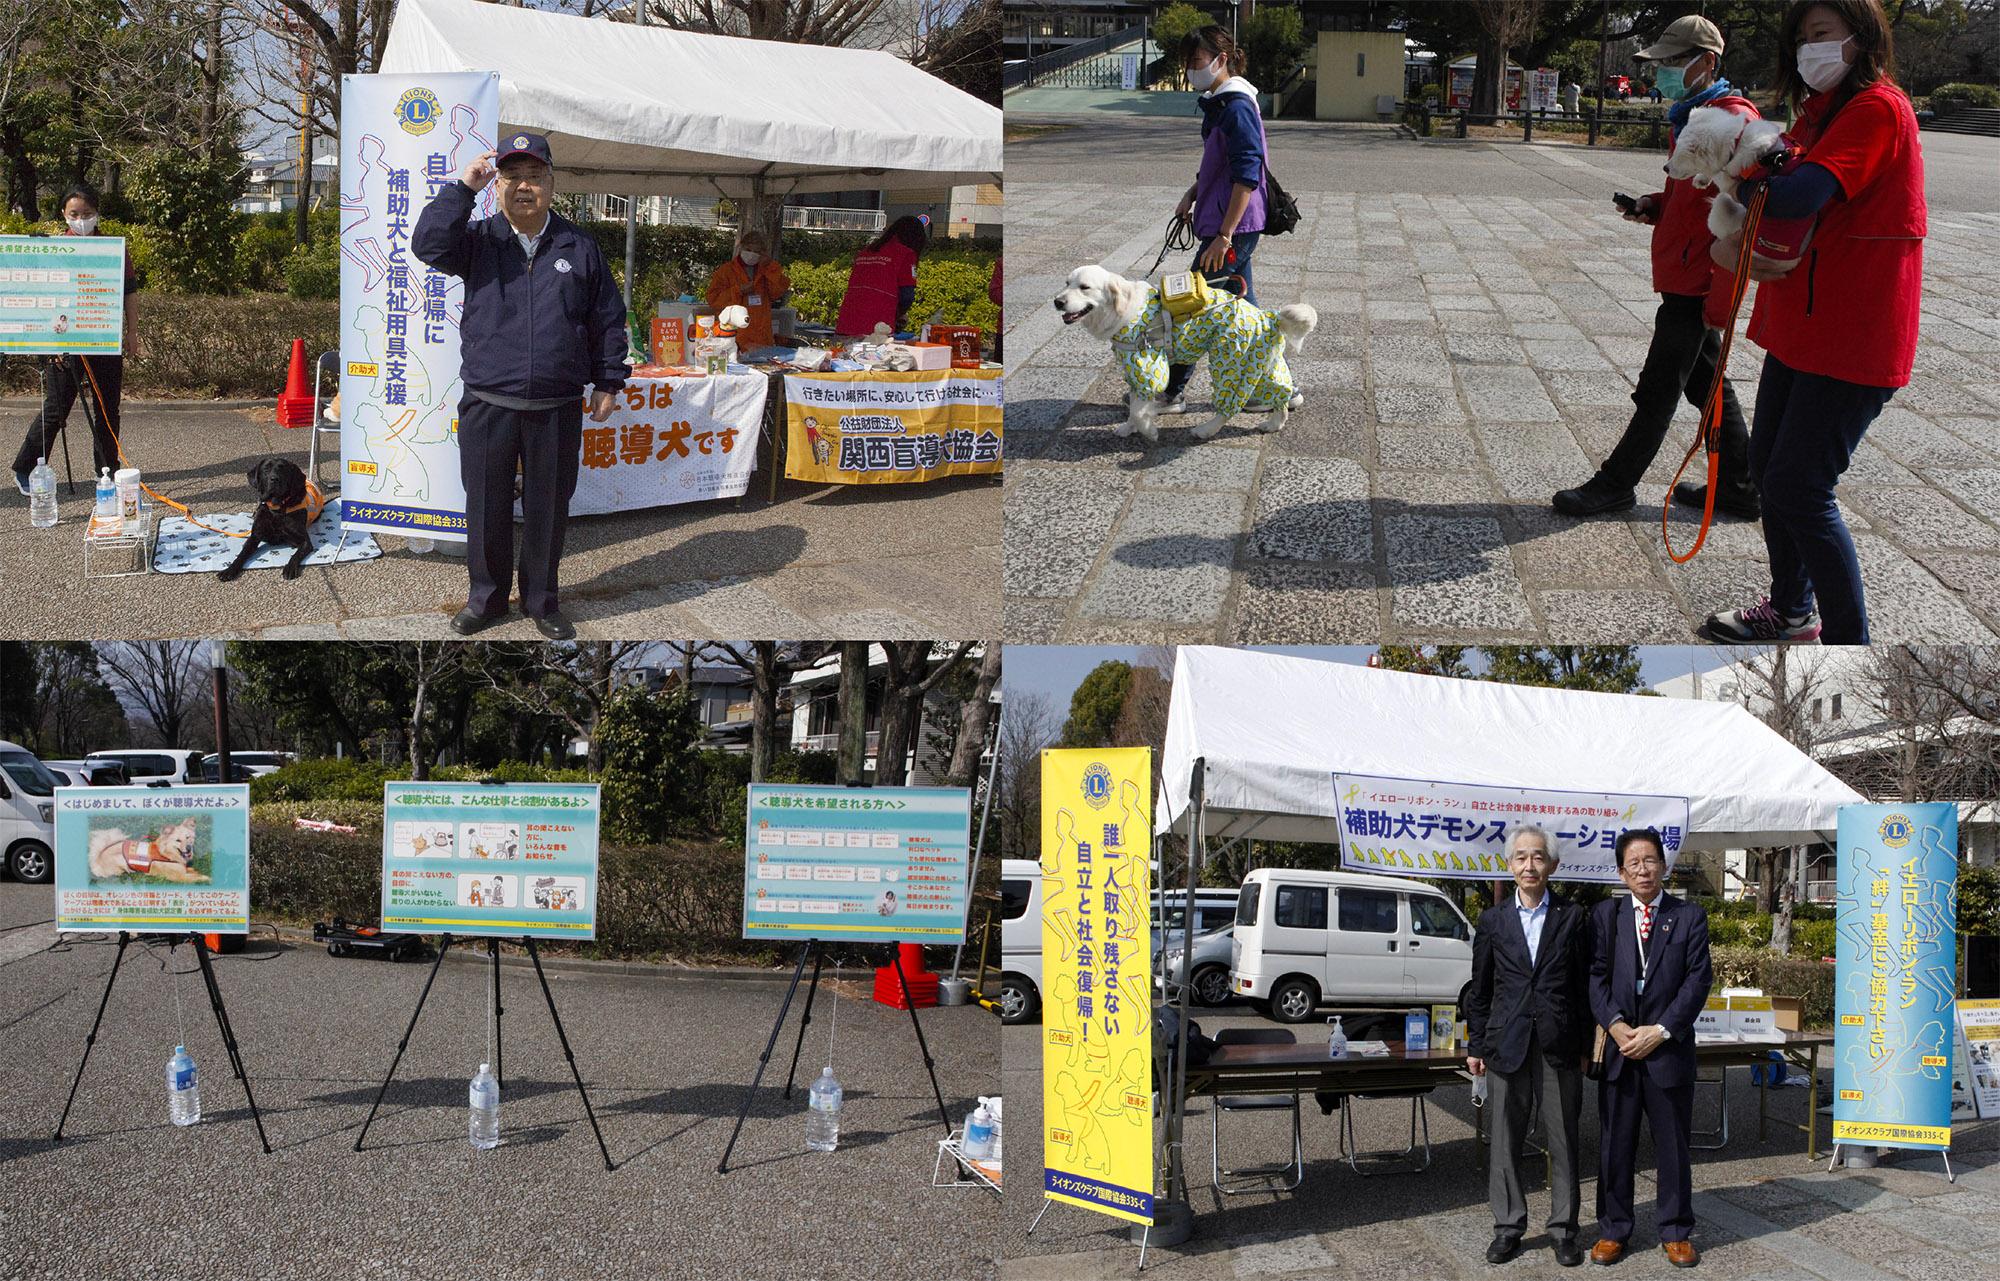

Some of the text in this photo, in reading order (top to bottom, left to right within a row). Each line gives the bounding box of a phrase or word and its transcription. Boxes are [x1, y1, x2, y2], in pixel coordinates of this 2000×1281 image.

[404, 90, 433, 100] LIONS
[413, 103, 425, 119] L
[424, 152, 447, 344] 自立復帰に
[386, 168, 409, 406] 補助犬と福祉用具支援
[350, 364, 376, 374] 介助犬
[840, 417, 905, 431] 公益財団法人
[582, 420, 740, 470] 聴導犬です
[840, 430, 999, 469] 関西盲導犬協会
[350, 462, 376, 474] 盲導犬
[1087, 765, 1108, 776] LIONS
[1093, 776, 1102, 792] L
[64, 796, 240, 809] <はじめまして、ぼくが聴導犬だよ。>
[394, 794, 590, 808] <聴導犬には、こんな仕事と役割があるよ>
[759, 797, 906, 810] <聴導犬を希望される方へ>
[1472, 800, 1619, 817] 自立と社会復帰を実現する為の取り組み
[1886, 814, 1907, 824] LIONS
[1344, 806, 1682, 851] 補助犬デモンスーショ場
[1892, 824, 1902, 836] L
[1560, 864, 1617, 872] ライオンズクラブ
[1104, 824, 1120, 1034] 誰一人取り残さない
[1900, 856, 1918, 1009] イエローリボン・ラン
[1870, 868, 1890, 1058] 「絆」基金にご協力下さい
[1842, 1016, 1864, 1024] 介助犬
[1050, 1031, 1072, 1044] 介助犬
[1127, 1096, 1148, 1108] 聴導犬
[1840, 1126, 1944, 1140] ライオンズクラブ国際協会335-C
[1051, 1176, 1146, 1210] ライオンズクラブ国際協会335-C
